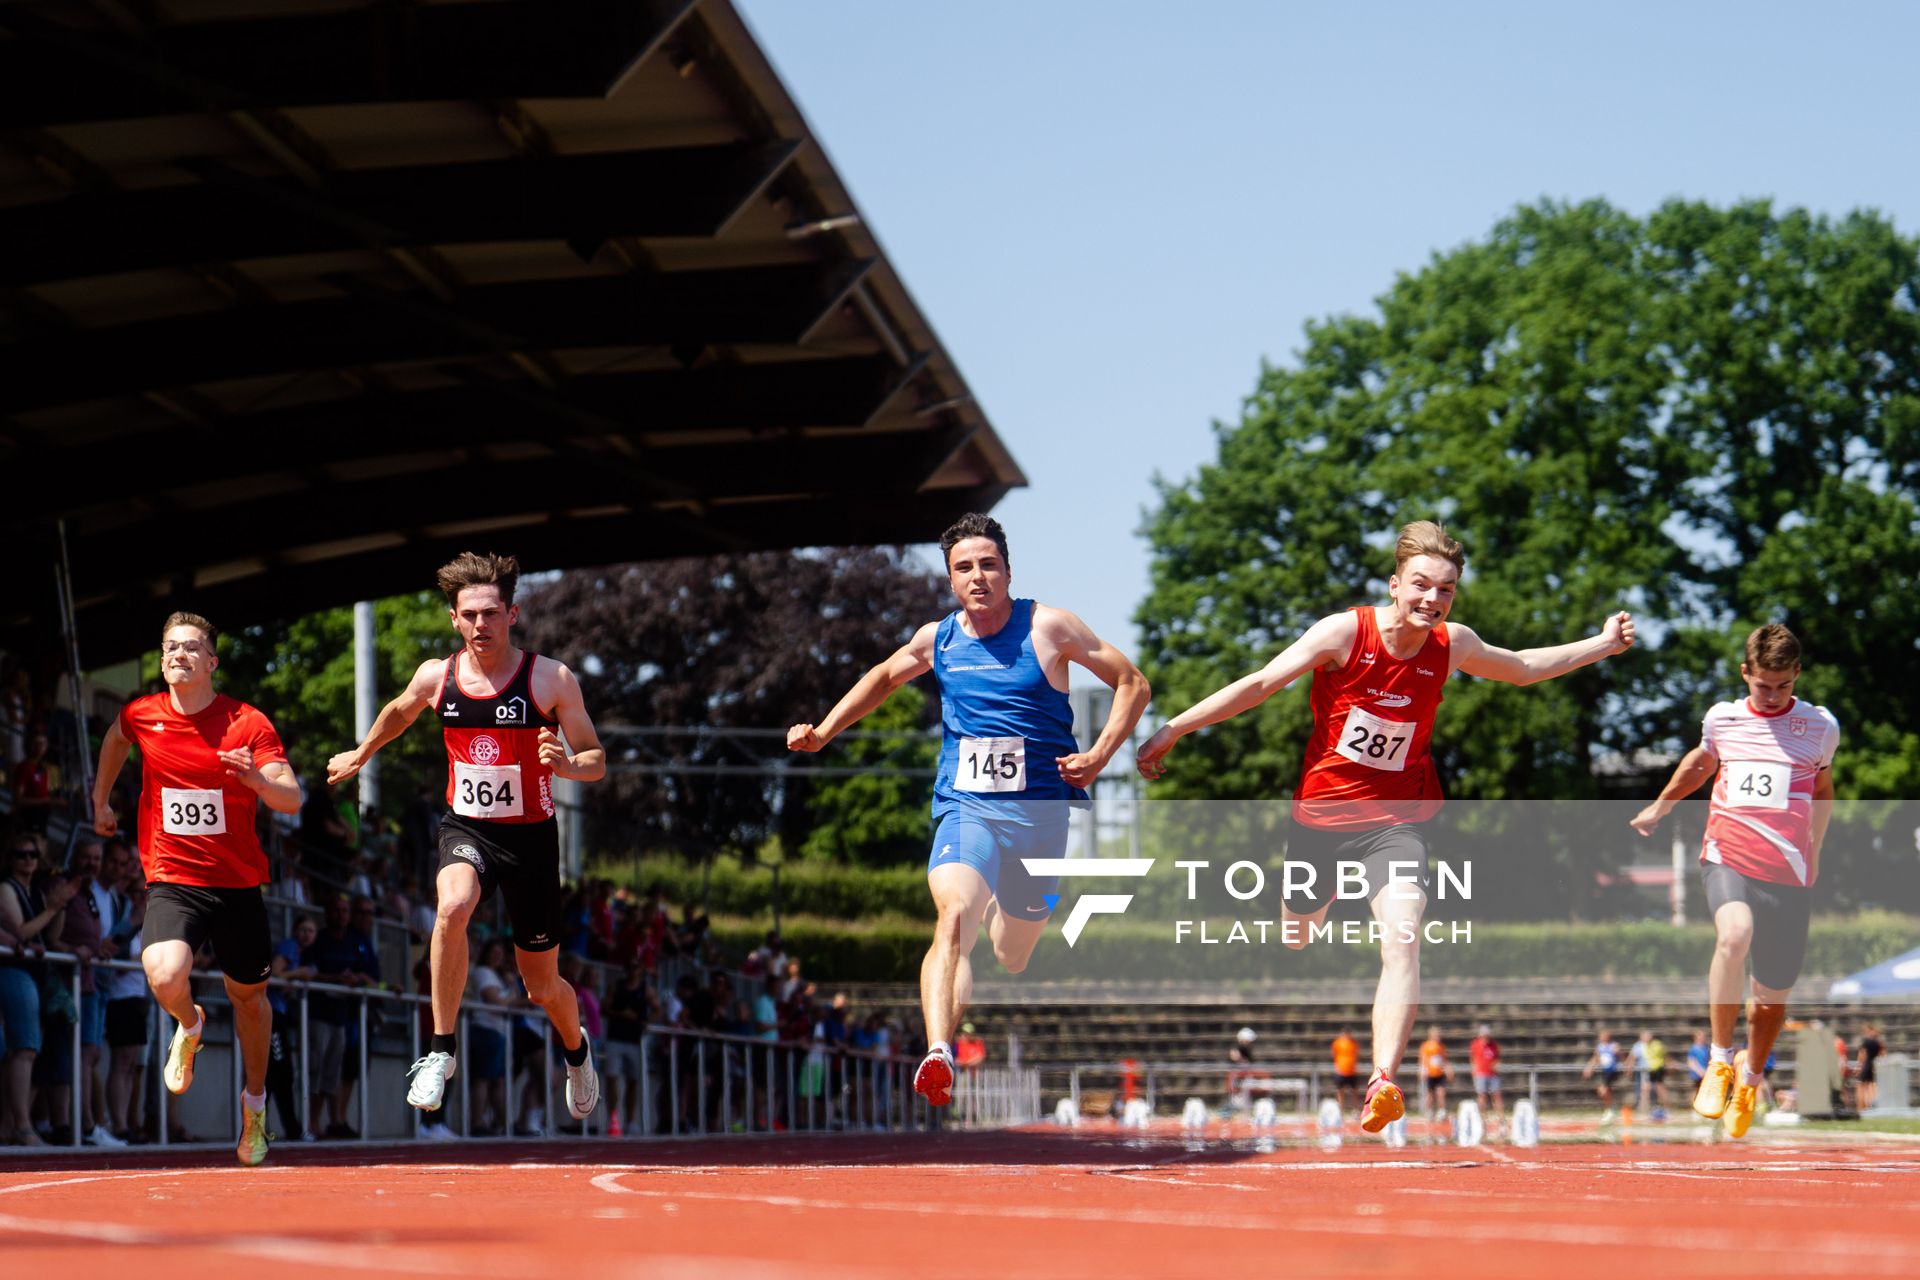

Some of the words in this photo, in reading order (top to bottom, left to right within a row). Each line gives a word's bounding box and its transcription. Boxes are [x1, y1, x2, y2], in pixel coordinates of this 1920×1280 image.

[495, 705, 517, 719] OS
[1347, 725, 1406, 761] 287
[968, 752, 1018, 780] 145
[462, 778, 514, 807] 364
[1739, 773, 1772, 797] 43
[170, 802, 218, 826] 393
